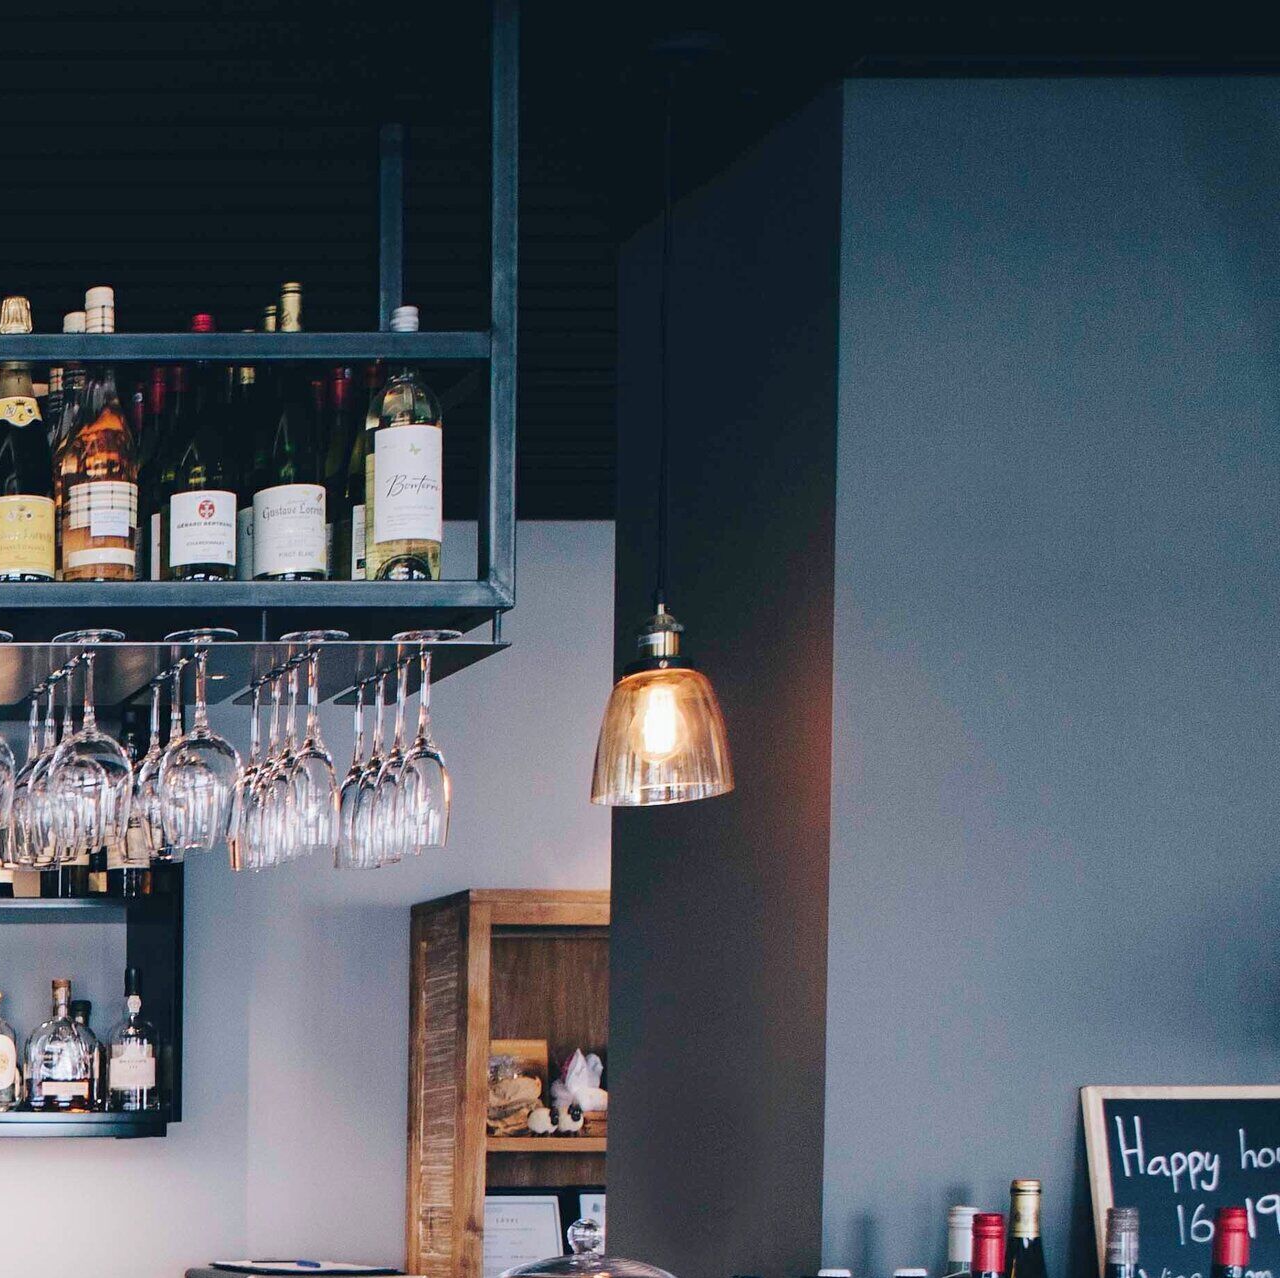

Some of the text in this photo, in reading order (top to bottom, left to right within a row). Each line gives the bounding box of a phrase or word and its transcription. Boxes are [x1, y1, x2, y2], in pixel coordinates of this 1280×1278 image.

[262, 506, 297, 520] Gustave
[277, 551, 297, 559] PINOT
[1114, 1115, 1280, 1194] Happy ho
[1176, 1194, 1280, 1246] 16 19
